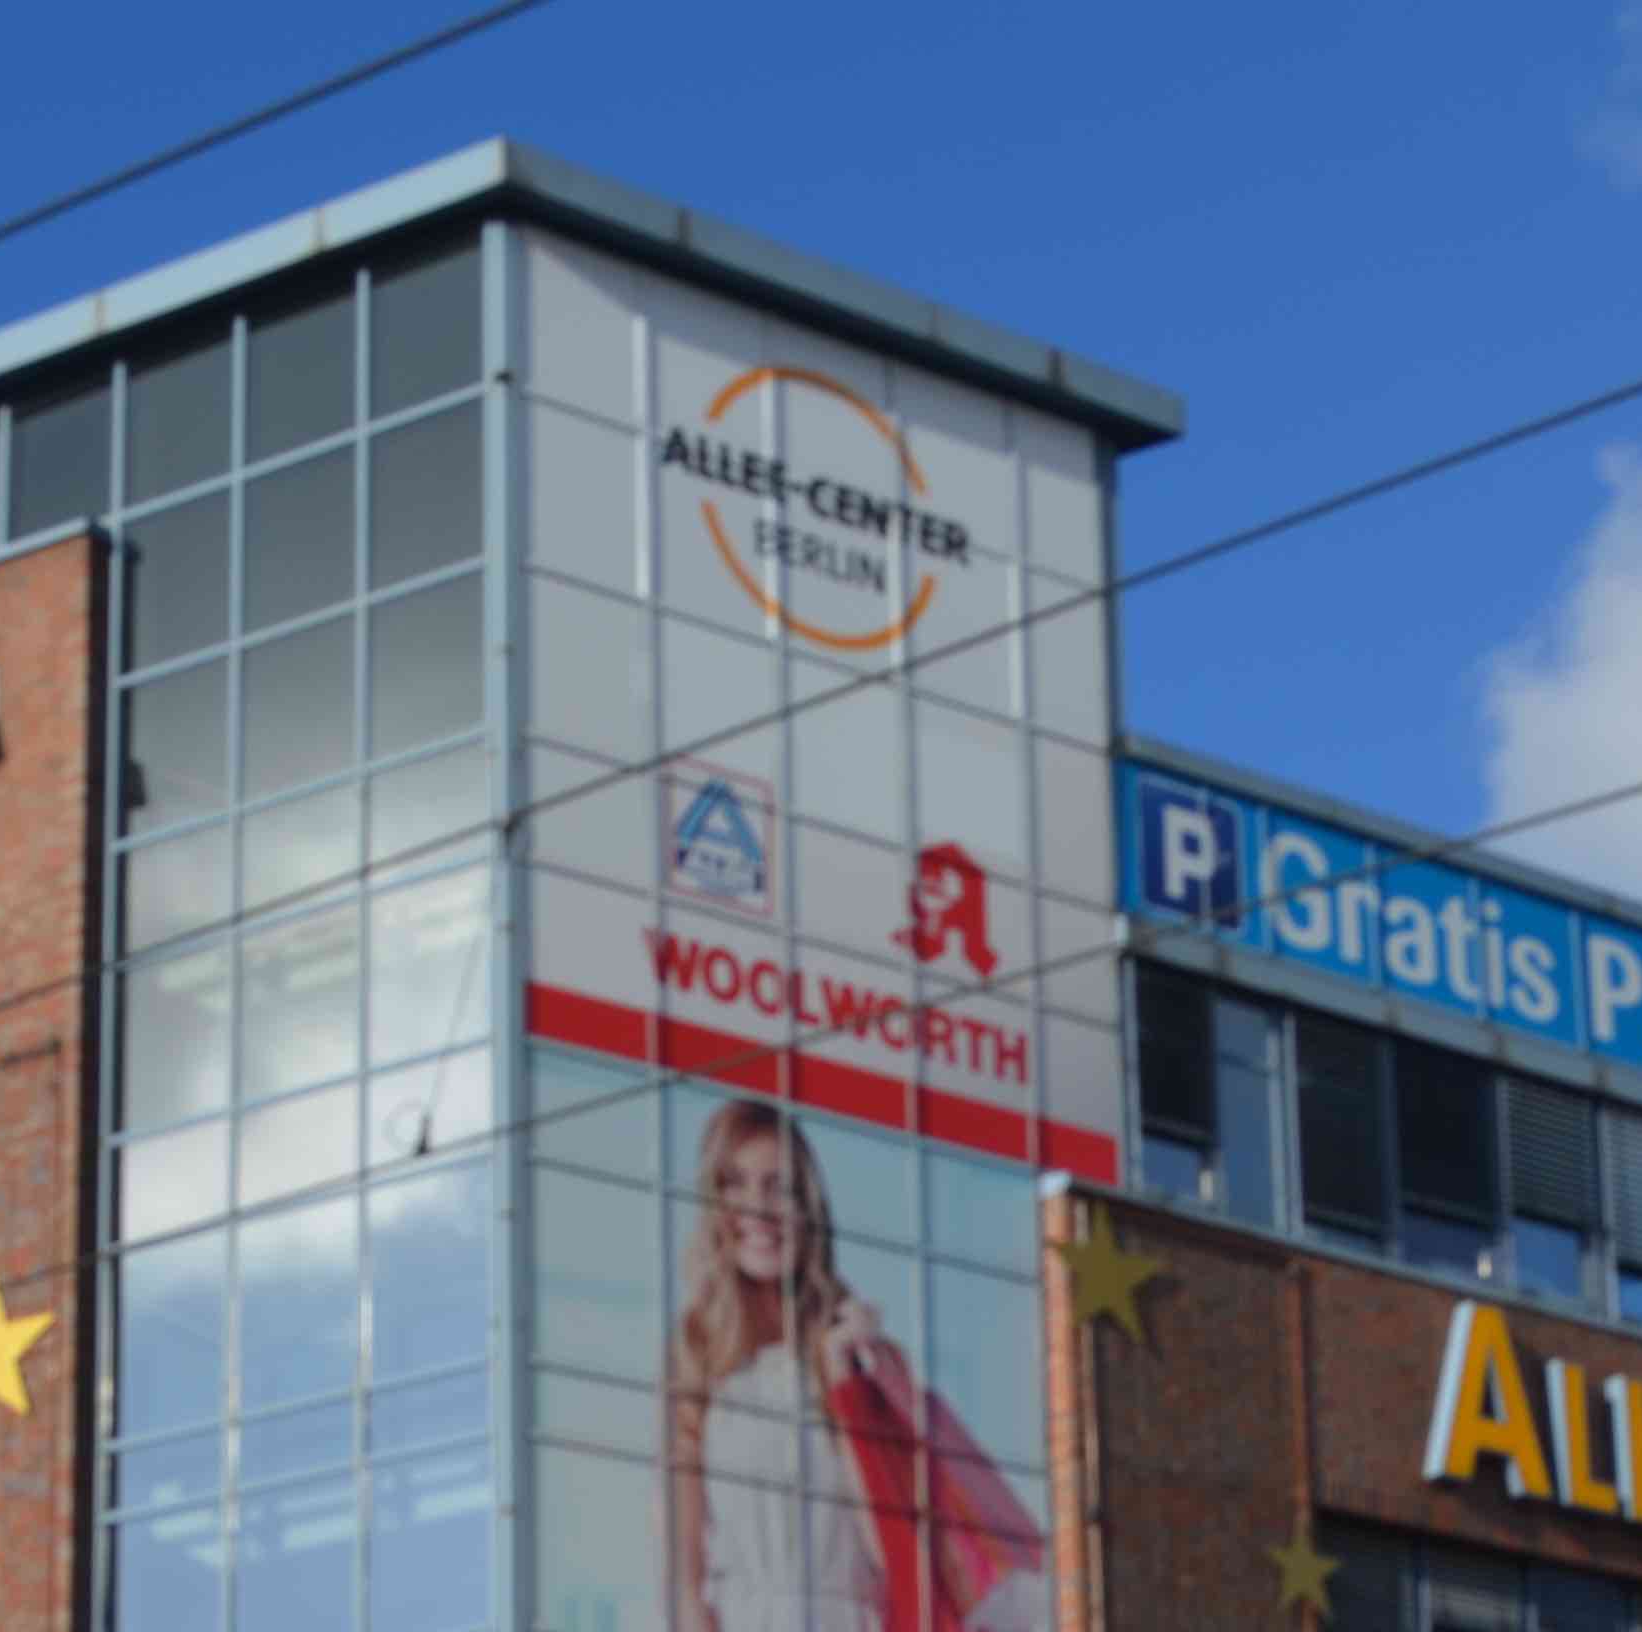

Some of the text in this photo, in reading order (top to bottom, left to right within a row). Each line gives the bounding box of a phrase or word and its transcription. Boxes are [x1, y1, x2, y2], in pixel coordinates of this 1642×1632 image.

[660, 426, 971, 567] ALLEE-CENTER
[753, 519, 889, 598] BERLIN
[1160, 804, 1220, 900] P
[1257, 830, 1559, 1026] Gratis
[642, 927, 1030, 1086] WOOLWORTH
